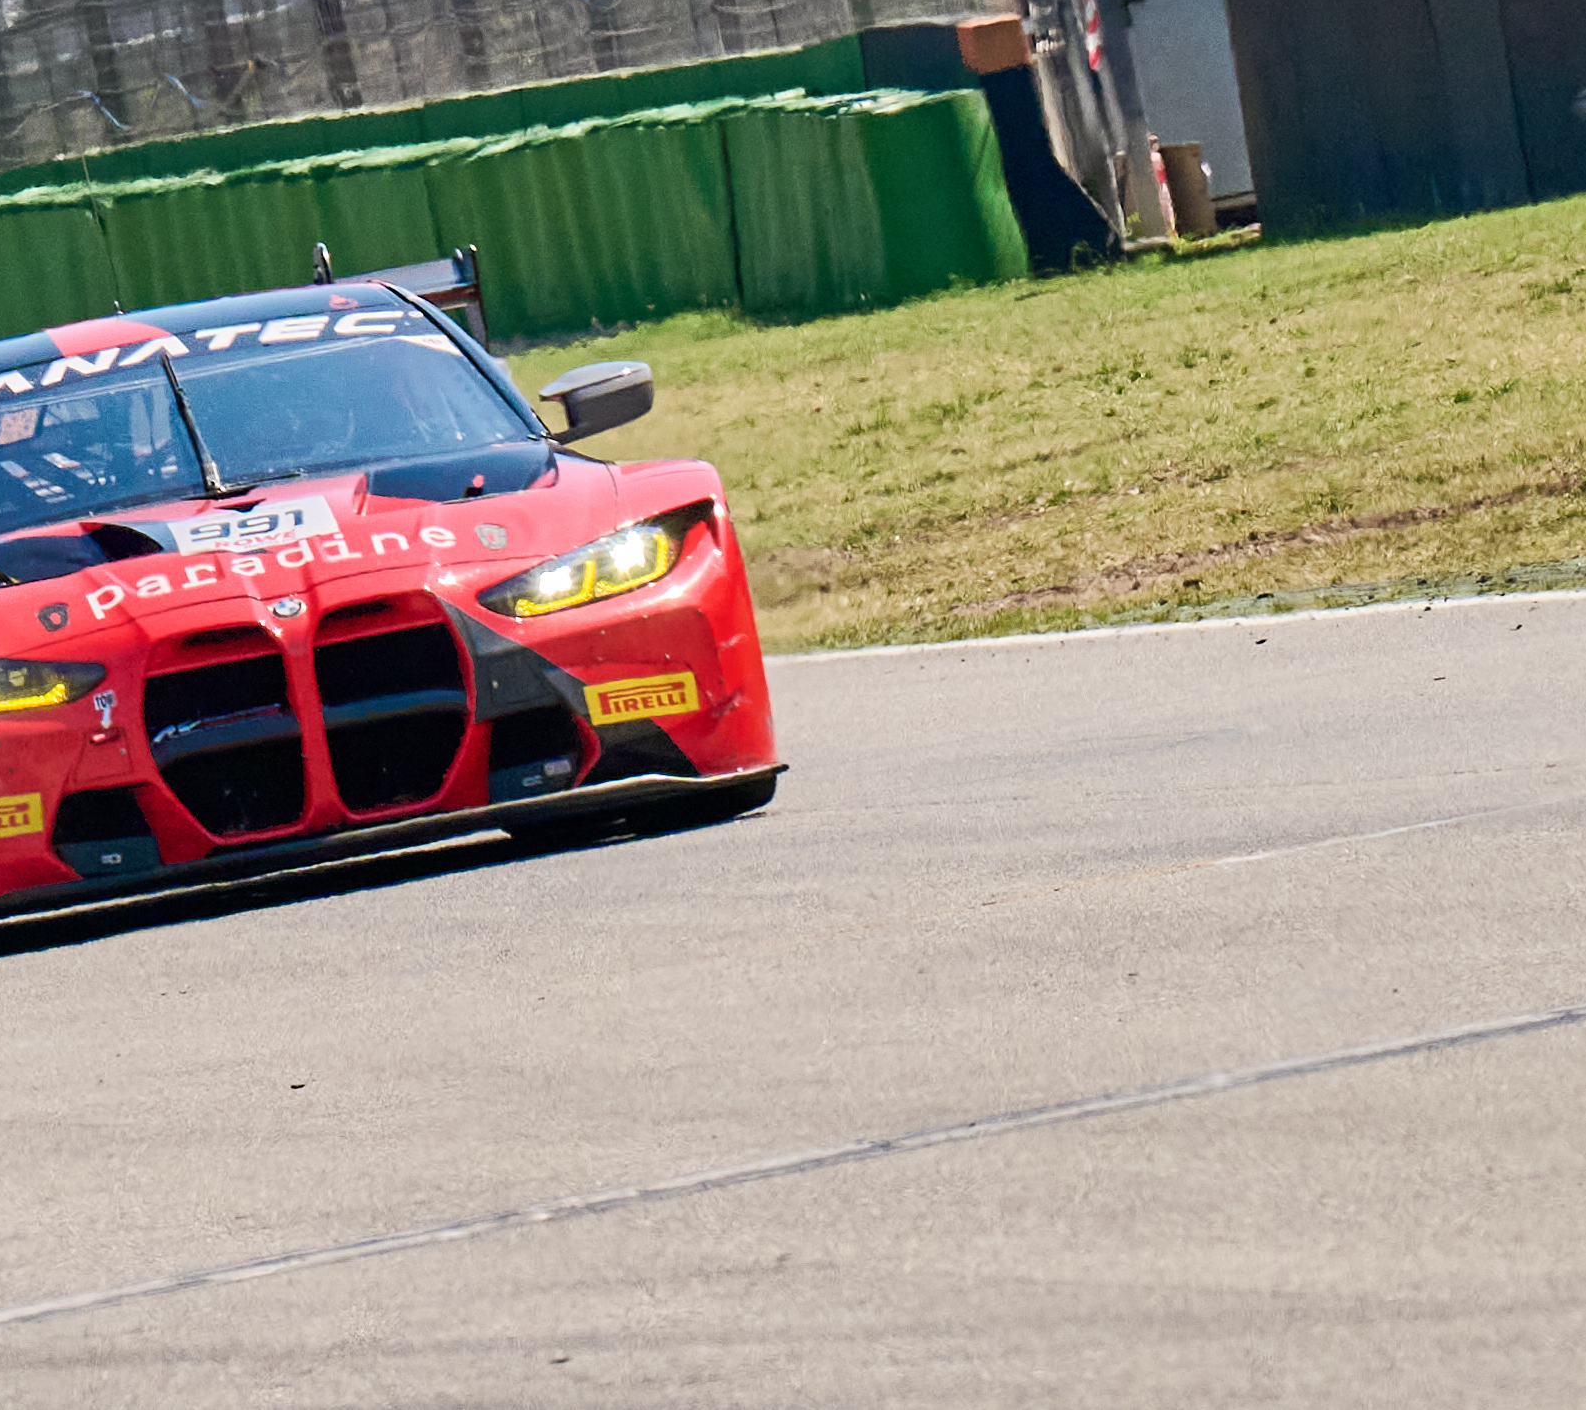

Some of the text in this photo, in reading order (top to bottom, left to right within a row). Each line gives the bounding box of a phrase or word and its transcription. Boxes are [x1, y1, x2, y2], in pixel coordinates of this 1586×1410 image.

[190, 509, 304, 542] 991
[214, 530, 297, 549] ROWE
[85, 525, 458, 619] paradine
[598, 681, 687, 716] PIRELLI
